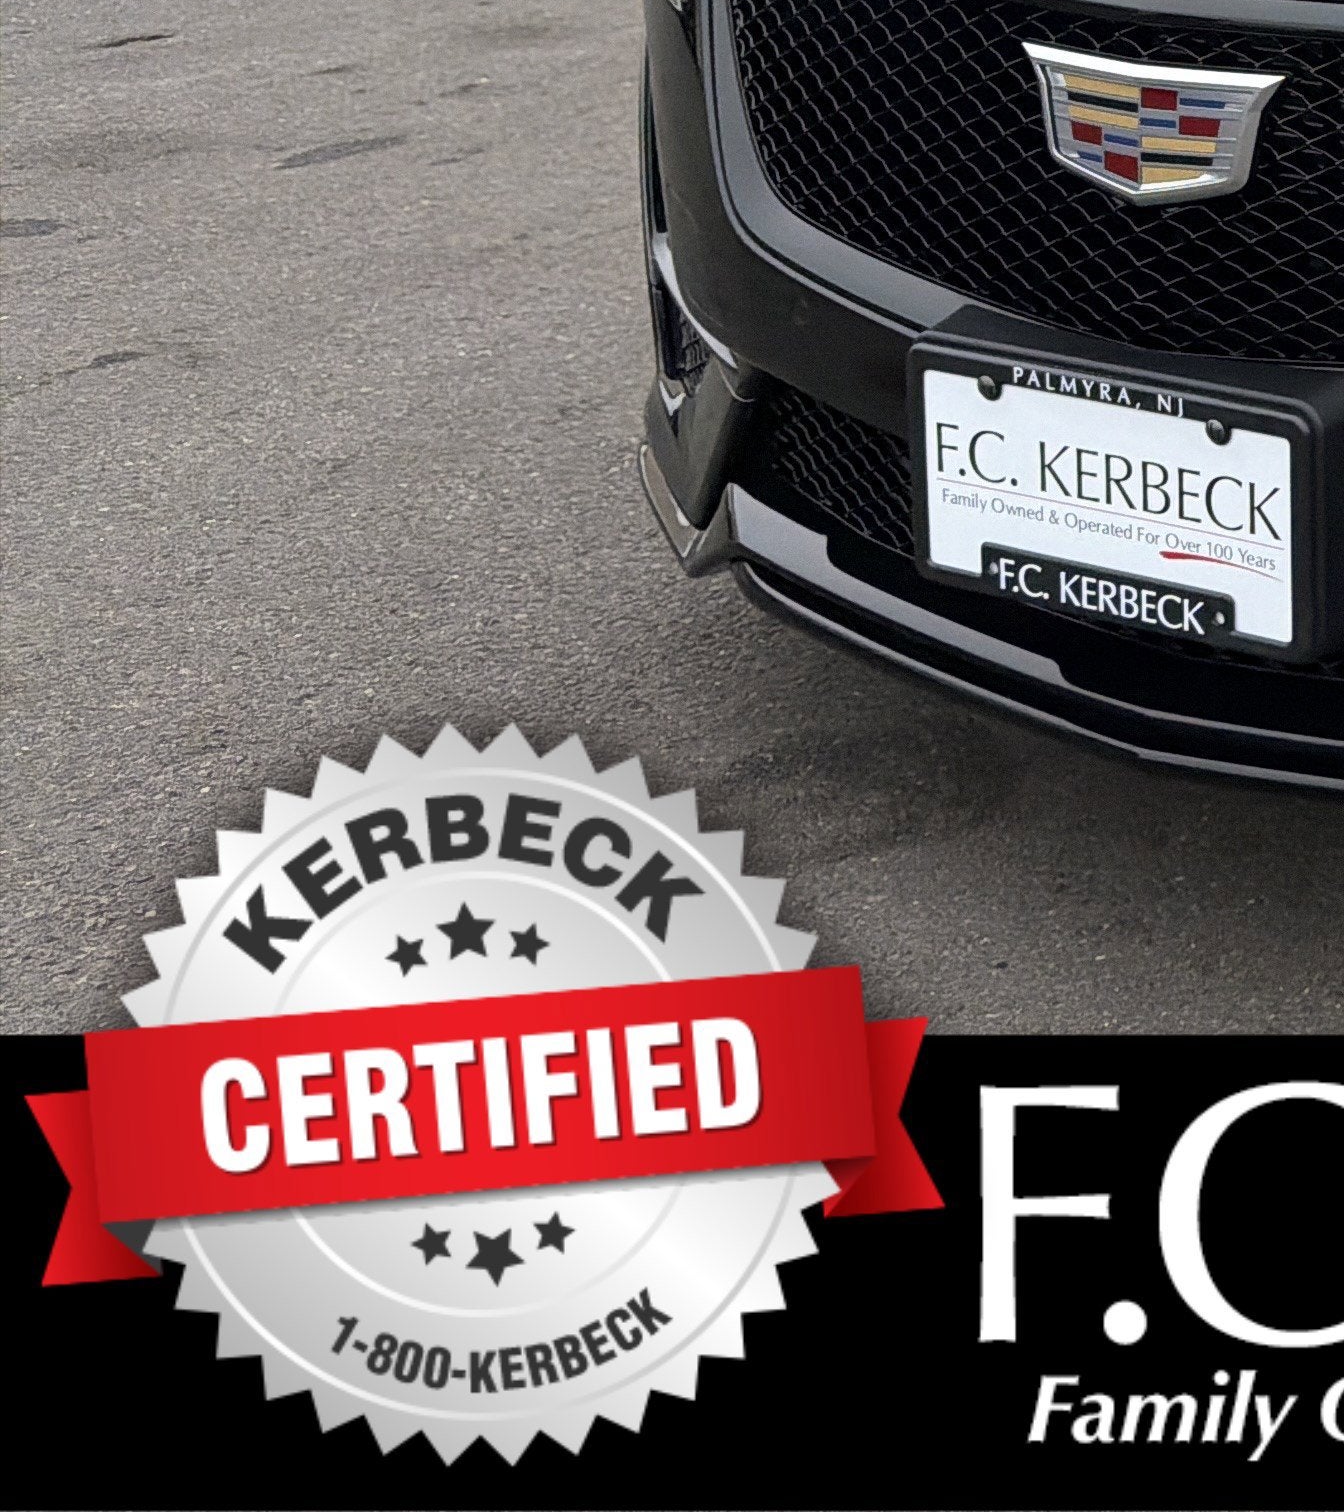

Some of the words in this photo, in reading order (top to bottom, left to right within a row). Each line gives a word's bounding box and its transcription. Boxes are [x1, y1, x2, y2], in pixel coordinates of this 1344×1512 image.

[1013, 366, 1143, 411] PALMYRA,
[1157, 395, 1185, 418] NJ
[935, 422, 1019, 487] F.C.
[1038, 440, 1282, 541] KERBECK
[941, 487, 988, 514] Family
[991, 496, 1044, 523] Owned
[1048, 509, 1060, 526] &
[1064, 511, 1134, 542] Operated
[1136, 524, 1161, 546] For
[1165, 532, 1202, 554] Over
[1206, 541, 1234, 561] 100
[1237, 547, 1277, 572] Years
[998, 558, 1049, 600] F.C.
[1059, 571, 1206, 635] KERBECK
